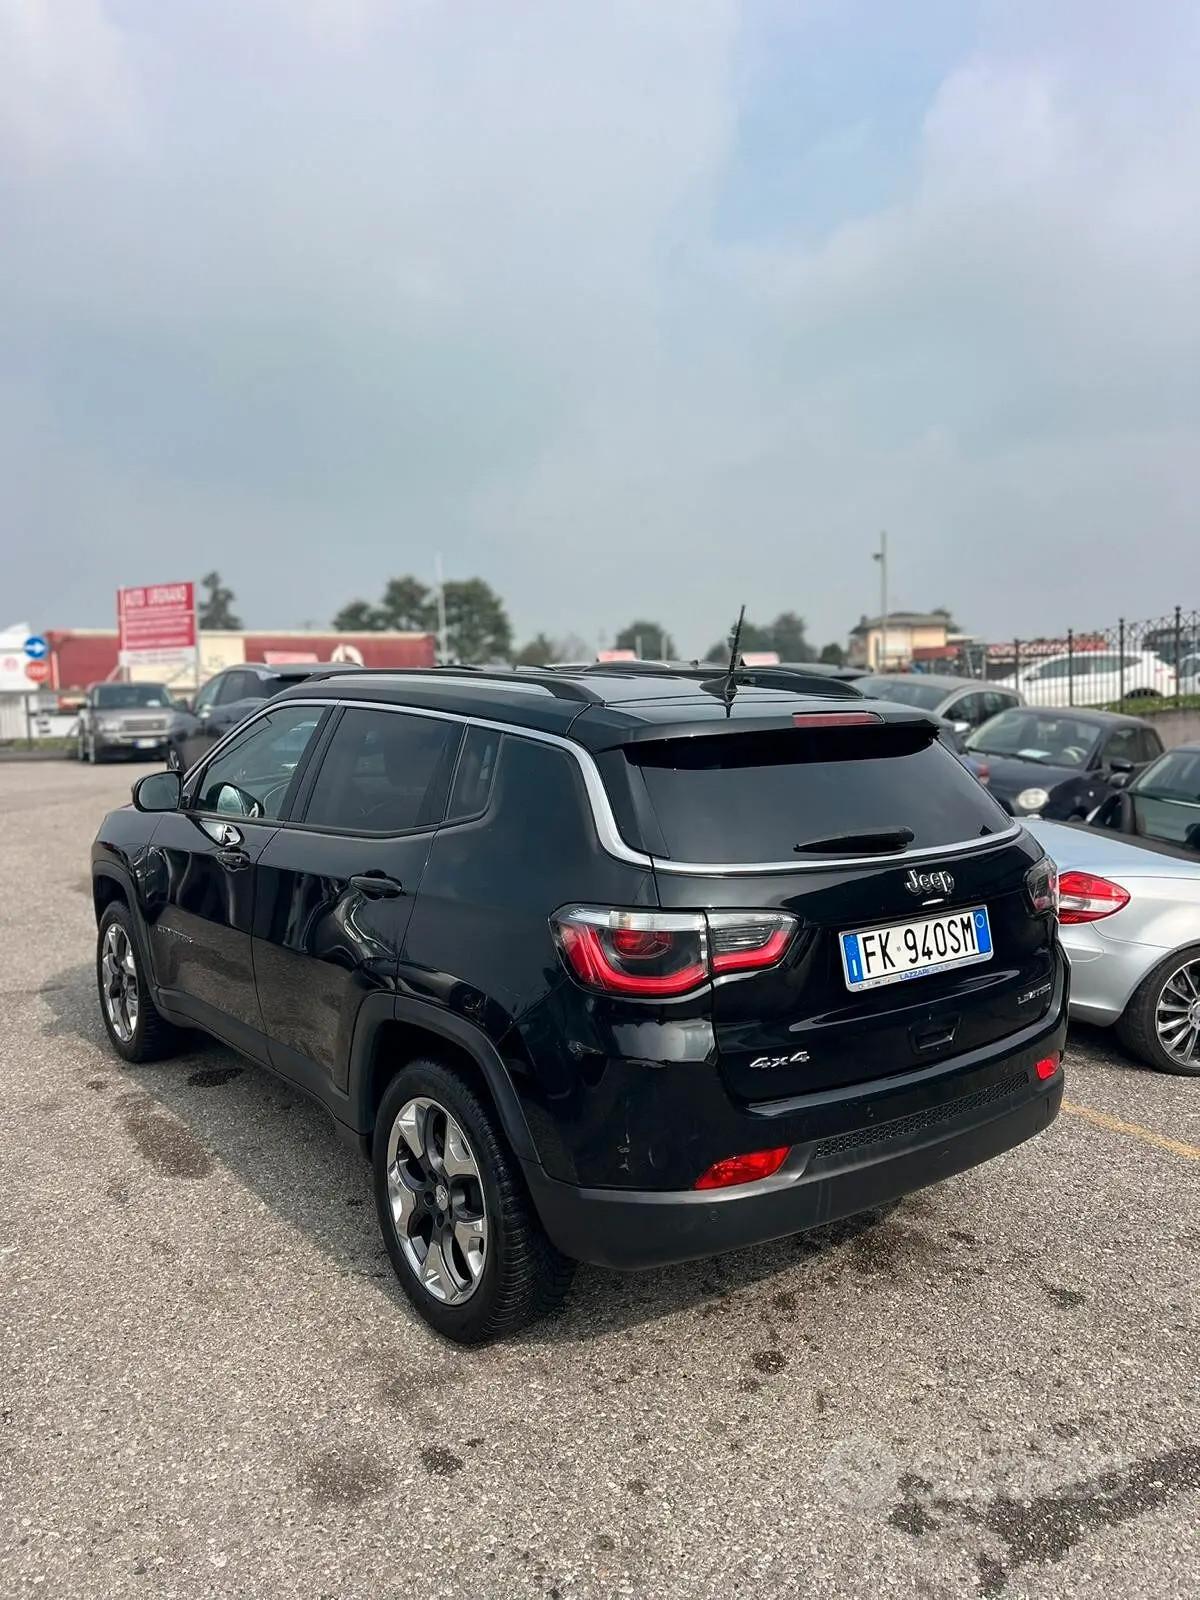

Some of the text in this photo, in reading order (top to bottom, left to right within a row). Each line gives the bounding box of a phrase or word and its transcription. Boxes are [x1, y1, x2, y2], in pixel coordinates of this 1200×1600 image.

[905, 869, 954, 895] Jeep
[861, 915, 976, 974] FK 940SM
[749, 1050, 810, 1069] 4x4
